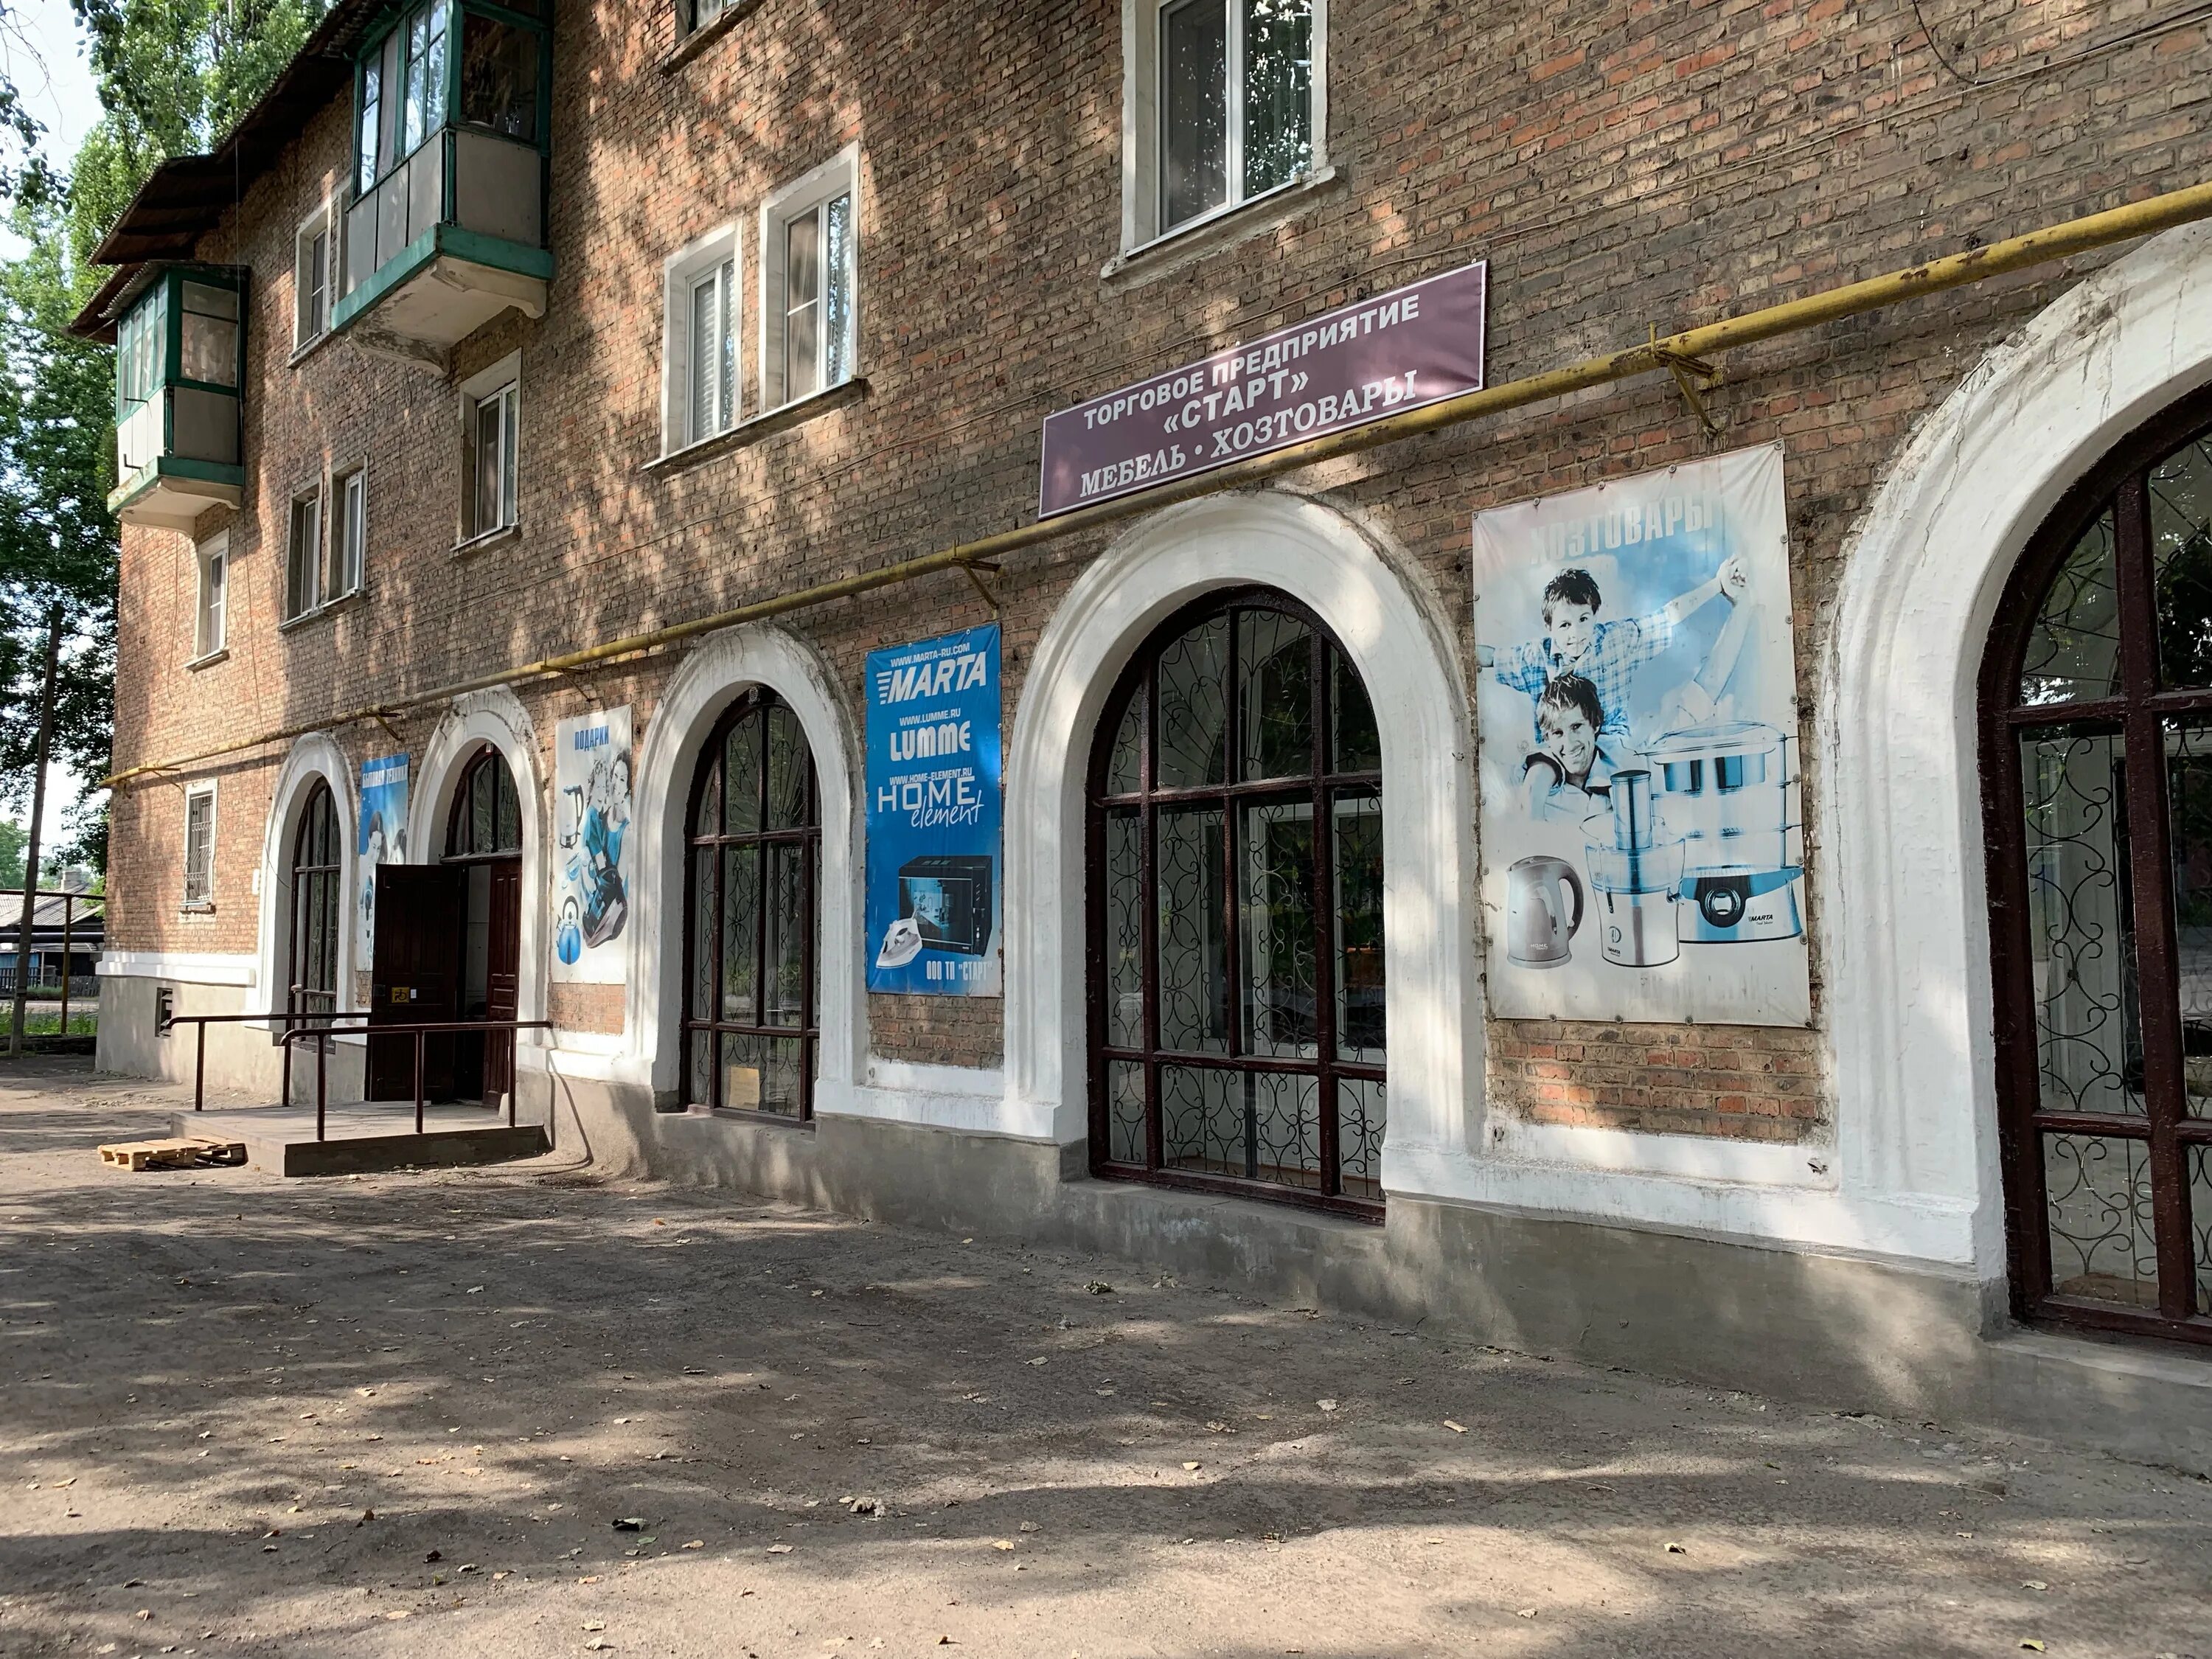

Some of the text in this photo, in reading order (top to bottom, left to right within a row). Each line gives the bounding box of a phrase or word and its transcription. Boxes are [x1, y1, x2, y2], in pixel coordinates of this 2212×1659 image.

[1084, 295, 1419, 430] ТОРГОВОЕ ПРЕДПРИЯТИЕ
[1163, 369, 1310, 434] «СТАРТ»
[1079, 369, 1418, 498] МЕБЕЛЬ ХОЗТОВАРЫ
[1530, 490, 1712, 565] ХОЗТОВАРЫ
[891, 642, 970, 667] WWW.MARTA-RU.COM
[887, 652, 987, 704] MARTA
[900, 708, 961, 726] WWW.LUMME.RU
[574, 725, 609, 751] ПОДАРКИ
[890, 720, 971, 762] LUMME
[878, 776, 975, 813] HOME
[889, 767, 973, 785] WWW.HOME-ELEMENT.RU
[911, 789, 984, 830] element
[926, 960, 942, 980] ООО
[945, 961, 955, 980] ТП
